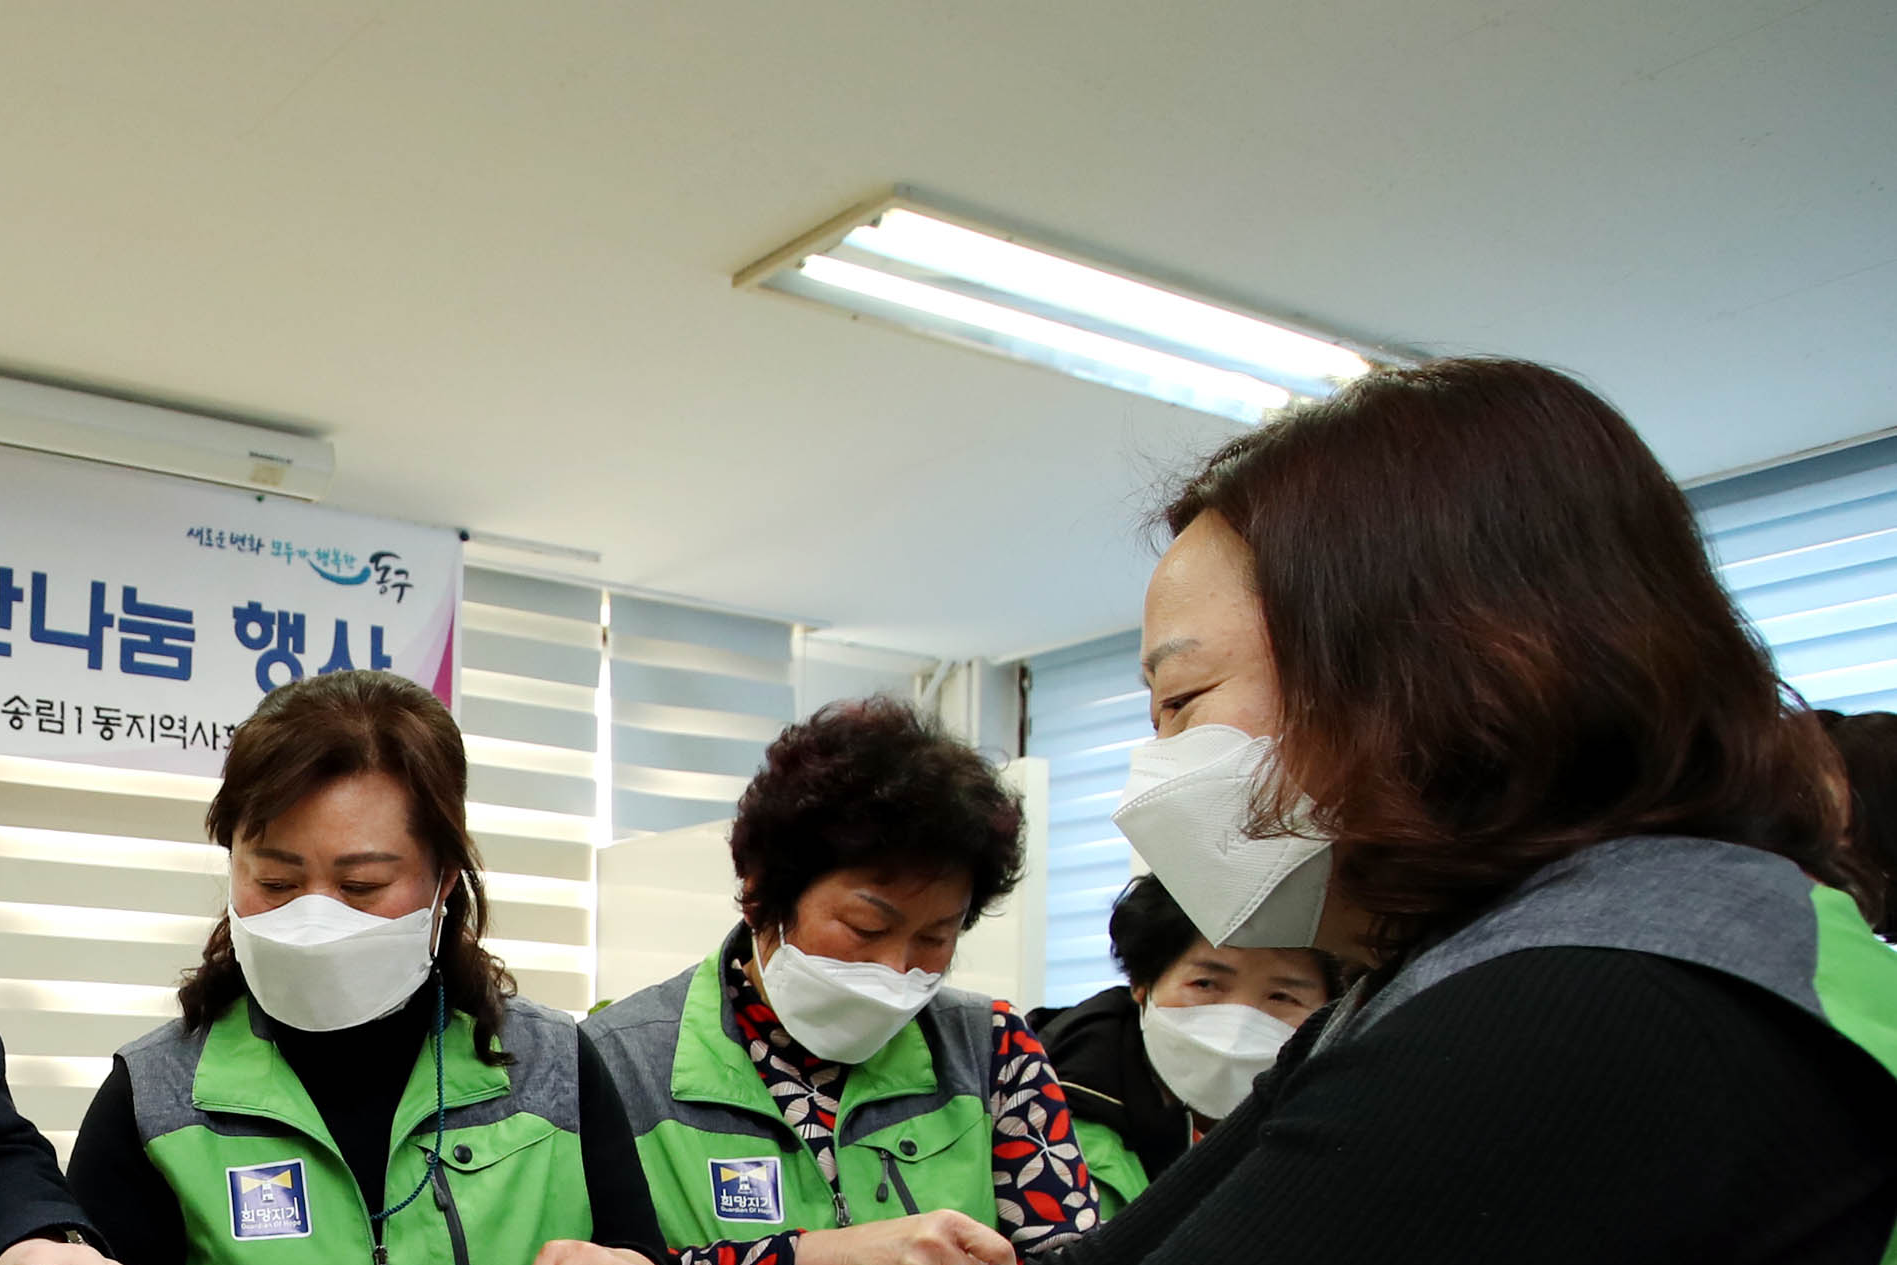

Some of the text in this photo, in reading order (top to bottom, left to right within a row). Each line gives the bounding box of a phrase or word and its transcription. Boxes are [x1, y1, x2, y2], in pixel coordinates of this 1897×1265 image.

[186, 526, 226, 549] 새로운
[229, 532, 264, 555] 변화
[368, 551, 414, 603] 동구
[240, 1196, 300, 1223] 희망지기
[720, 1188, 773, 1209] 희망지기
